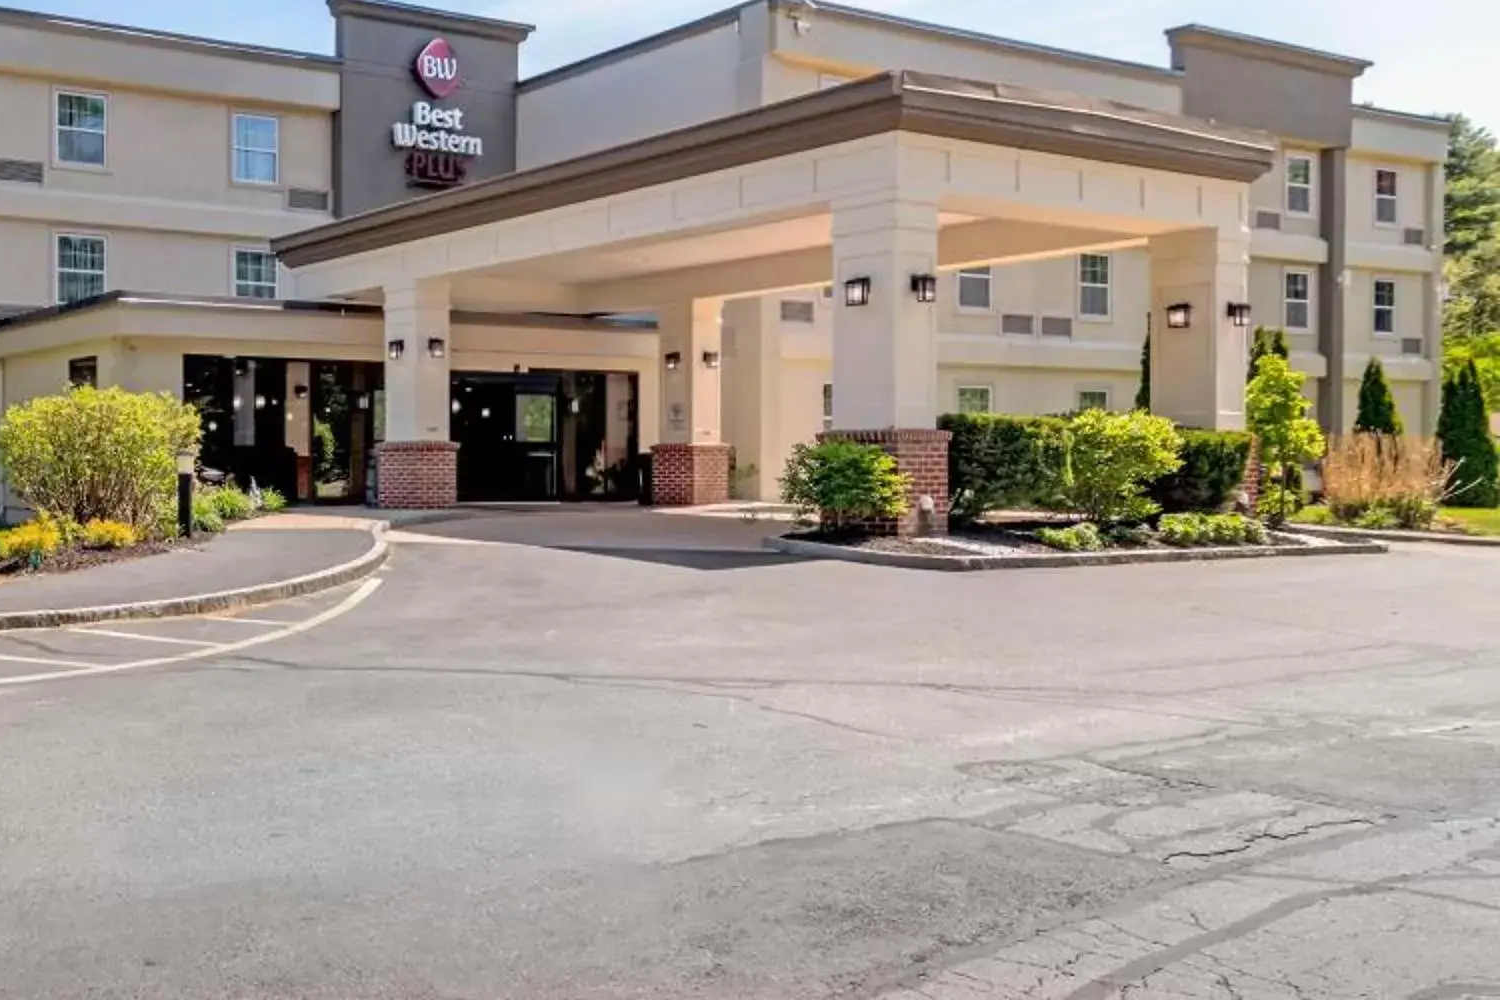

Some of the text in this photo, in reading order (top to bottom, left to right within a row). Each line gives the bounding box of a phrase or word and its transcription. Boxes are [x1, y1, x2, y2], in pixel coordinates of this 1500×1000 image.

[423, 55, 457, 80] BW
[413, 101, 463, 129] Best
[392, 122, 483, 155] Western
[412, 153, 466, 179] PLUS
